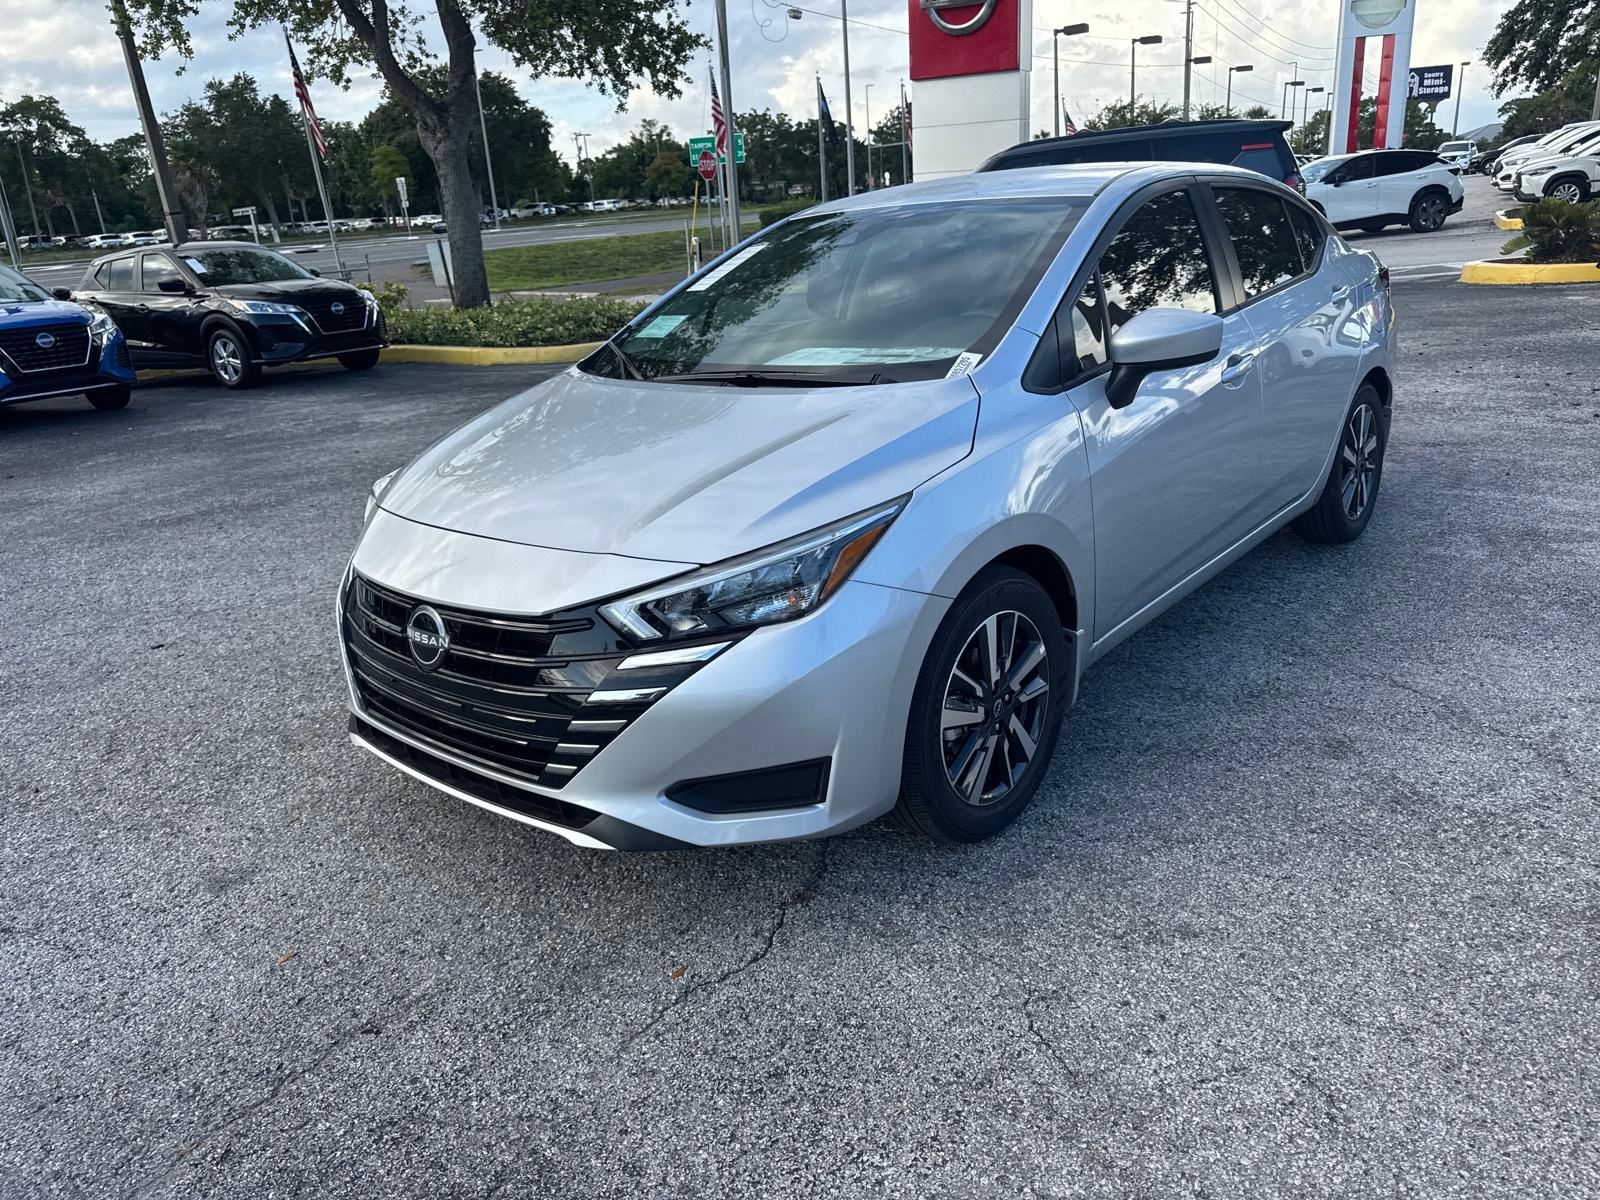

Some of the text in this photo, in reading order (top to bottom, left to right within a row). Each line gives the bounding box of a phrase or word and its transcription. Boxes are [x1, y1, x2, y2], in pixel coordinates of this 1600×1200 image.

[1423, 78, 1447, 86] Mini-
[1418, 86, 1449, 95] Storage
[700, 160, 715, 171] STOP
[407, 626, 449, 648] NISSAN
